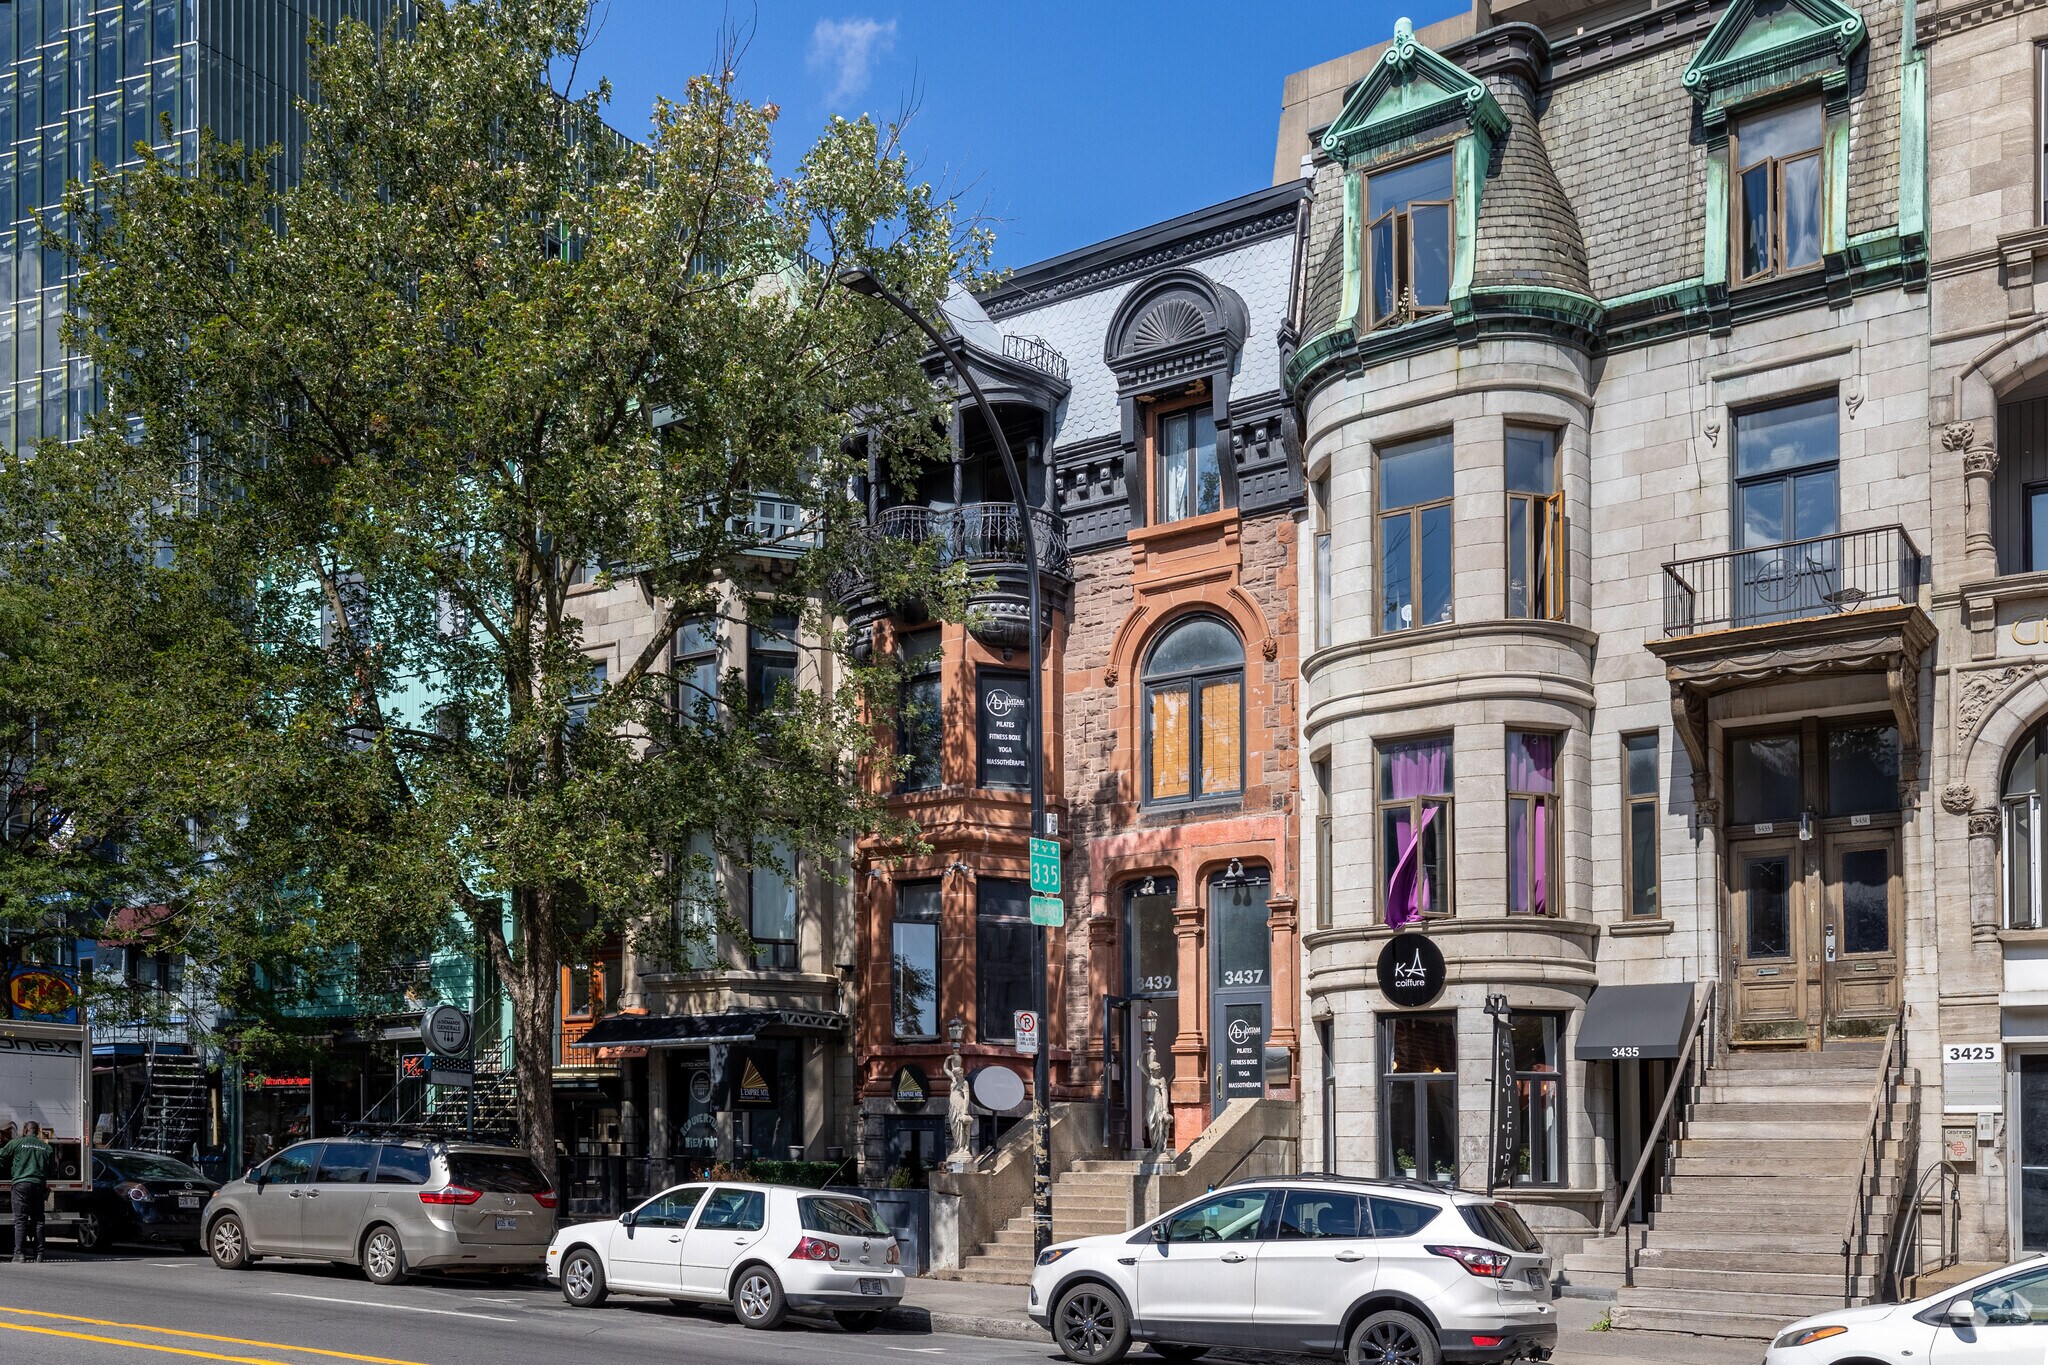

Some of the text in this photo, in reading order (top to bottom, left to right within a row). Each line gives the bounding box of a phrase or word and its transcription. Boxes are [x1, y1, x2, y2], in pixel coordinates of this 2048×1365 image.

[2012, 612, 2048, 645] G
[986, 758, 1025, 767] MASSOTHÉRAPIE
[1033, 862, 1058, 886] 335
[1137, 975, 1172, 991] 3439
[1224, 969, 1263, 985] 3437
[1395, 978, 1425, 988] coiffure
[1612, 1047, 1640, 1058] 3435
[1950, 1047, 1995, 1061] 3425
[741, 1088, 759, 1096] L'EMPIRE
[1228, 1081, 1261, 1089] MASSOTHÉRAPIE
[1502, 1058, 1513, 1181] COIFFURE
